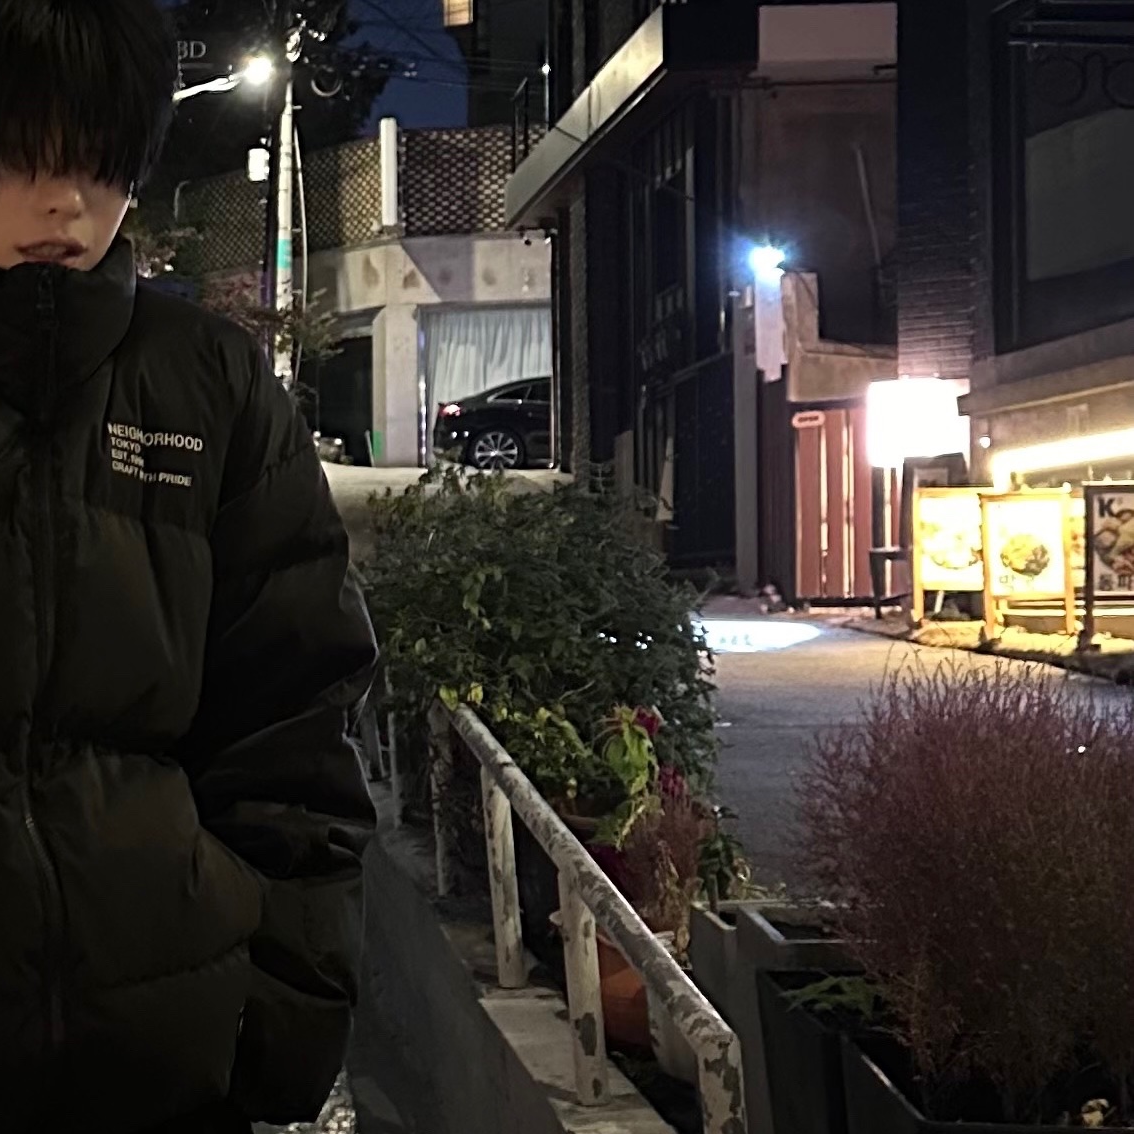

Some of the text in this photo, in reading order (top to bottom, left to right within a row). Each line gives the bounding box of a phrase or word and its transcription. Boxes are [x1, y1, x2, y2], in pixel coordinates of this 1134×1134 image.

[107, 423, 203, 452] NEIGHORHOOD
[110, 436, 142, 454] TOKYO
[112, 460, 139, 478] CRAFT
[158, 472, 192, 487] PRIDE
